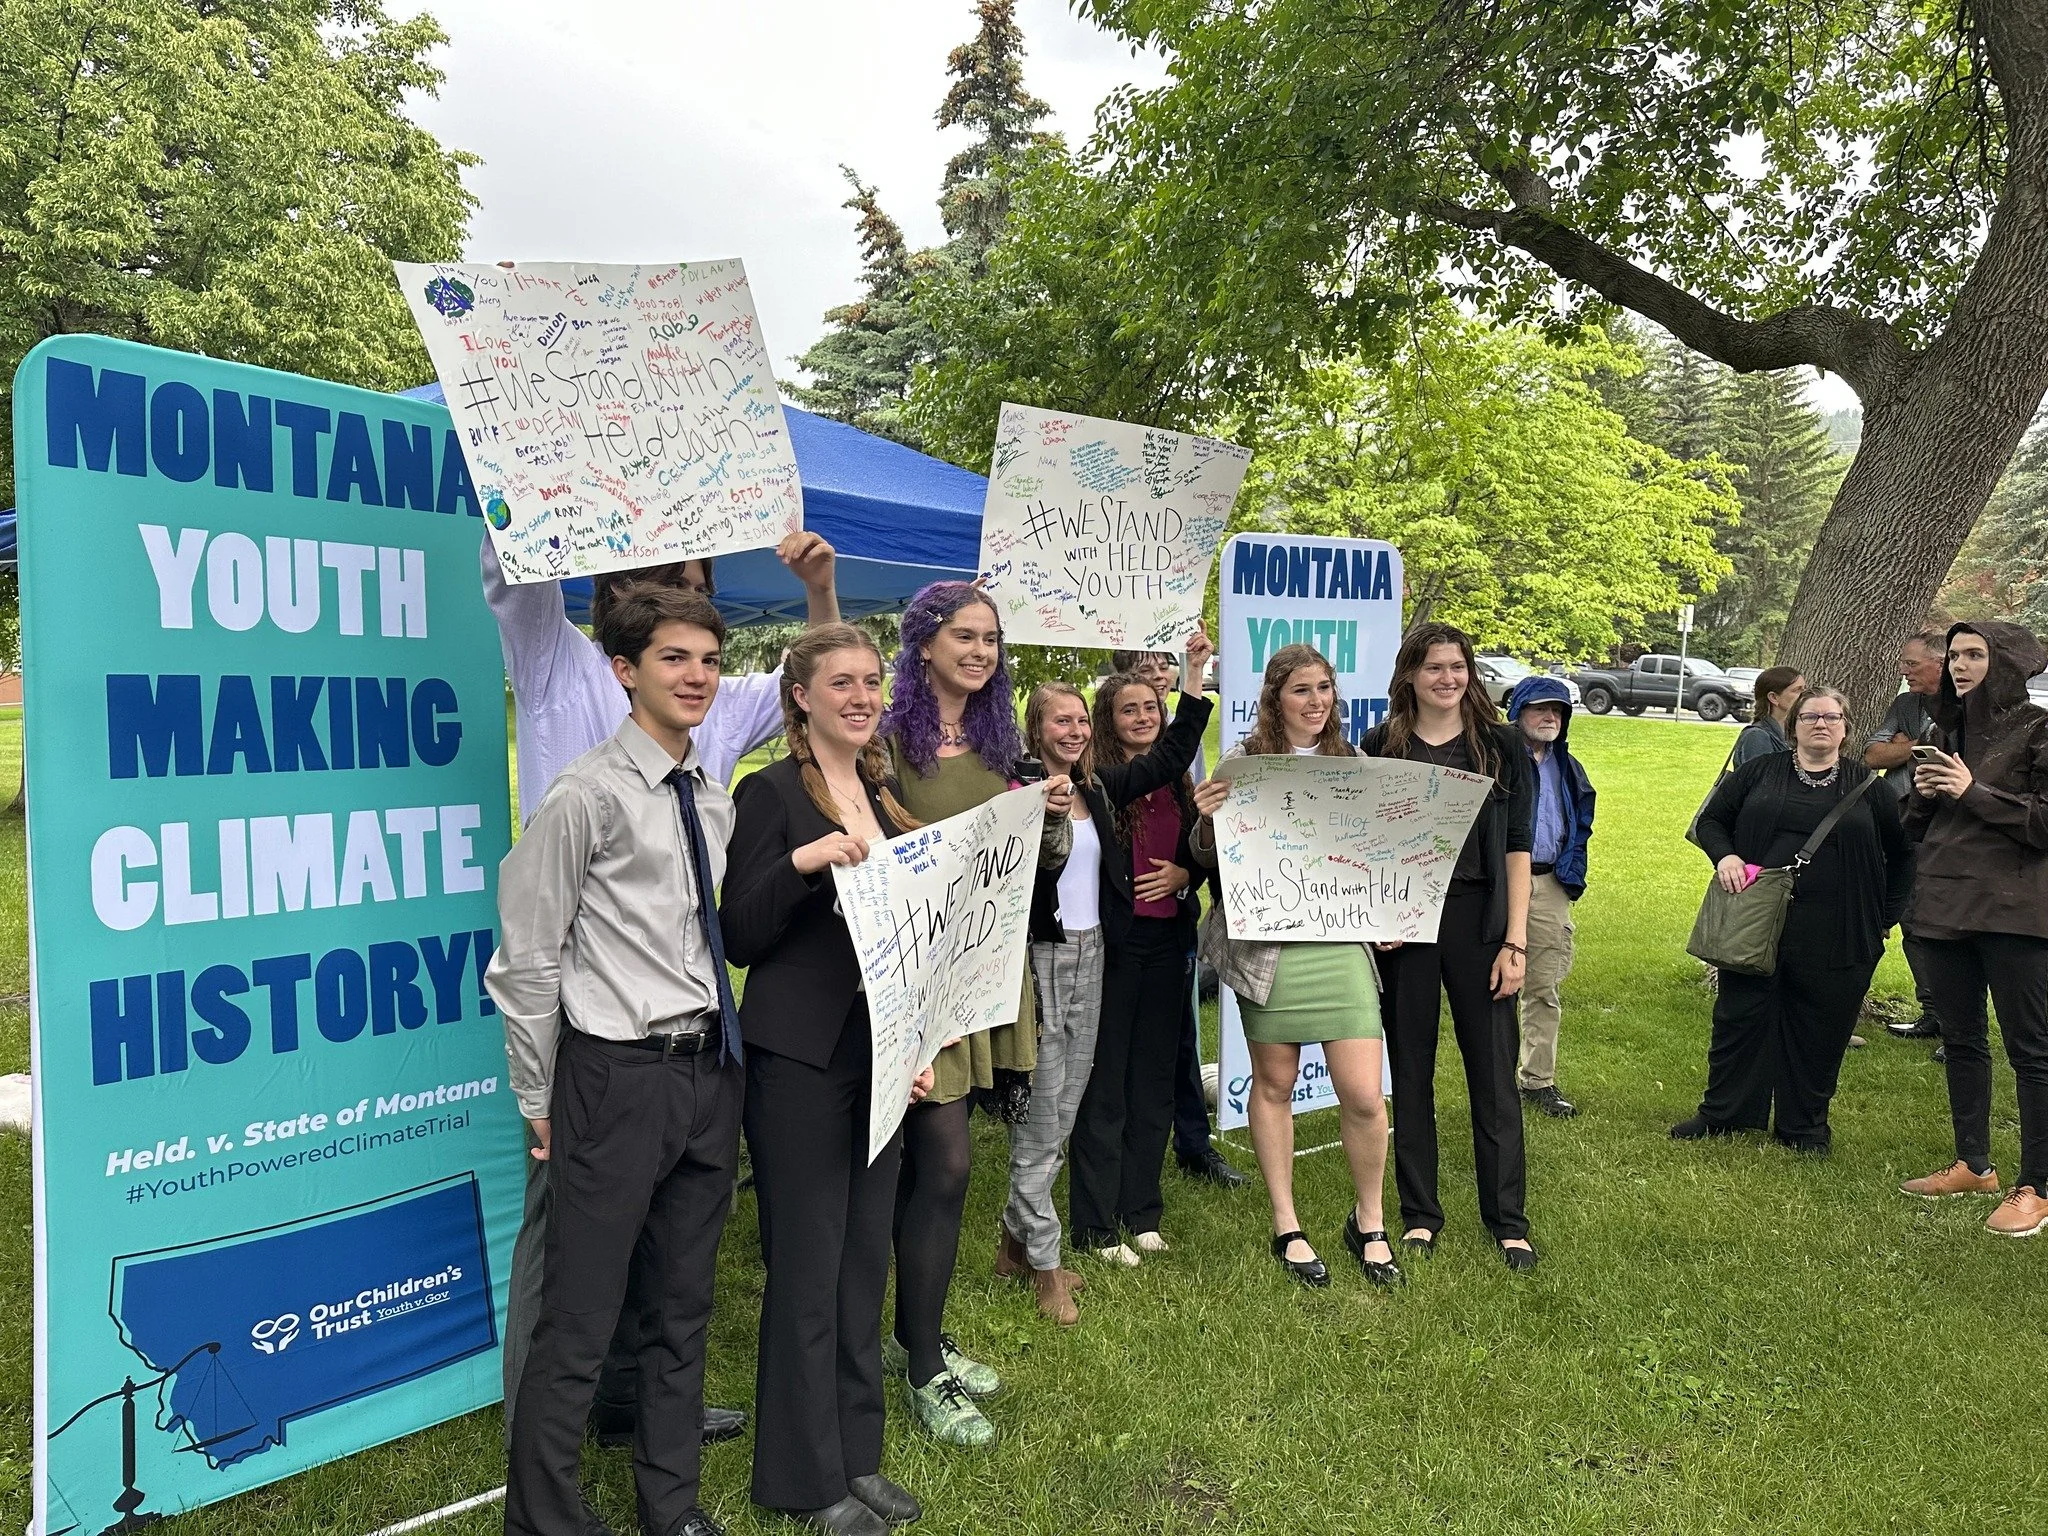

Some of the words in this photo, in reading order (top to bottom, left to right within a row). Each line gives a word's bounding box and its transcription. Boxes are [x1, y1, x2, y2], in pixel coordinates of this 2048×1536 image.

[688, 265, 724, 281] DYLAN
[479, 295, 500, 307] Avery
[537, 312, 568, 348] Dillon
[573, 319, 592, 331] Ben
[459, 335, 473, 352] I
[473, 331, 512, 354] Love
[722, 373, 754, 402] Linnea
[46, 356, 485, 518] MONTANA
[502, 422, 515, 441] I
[532, 410, 582, 436] DEAN
[516, 441, 548, 458] Great
[476, 454, 503, 476] Heath
[731, 483, 763, 504] OTTO
[697, 517, 734, 543] fighting
[1022, 495, 1182, 550] #WESTAND
[610, 544, 660, 558] Jackson
[1064, 547, 1097, 562] WITH
[1108, 543, 1172, 572] HELD
[138, 523, 427, 639] YOUTH
[1063, 566, 1163, 602] YOUTH
[1232, 540, 1393, 600] MONTANA
[106, 674, 463, 780] MAKING
[1306, 769, 1340, 777] Thank
[919, 833, 930, 847] all
[1275, 842, 1310, 851] Lehman
[90, 803, 485, 931] CLIMATE
[89, 928, 496, 1087] HISTORY!
[105, 1136, 196, 1177] Held.
[207, 1133, 234, 1153] v.
[243, 1109, 328, 1147] State
[337, 1099, 369, 1124] of
[374, 1075, 498, 1121] Montana
[125, 1110, 472, 1205] #YouthPoweredClimateTrial
[309, 1302, 353, 1322] Our
[354, 1265, 463, 1310] Children's
[311, 1311, 374, 1340] Trust
[376, 1300, 414, 1321] Youth
[425, 1289, 451, 1304] Gov
